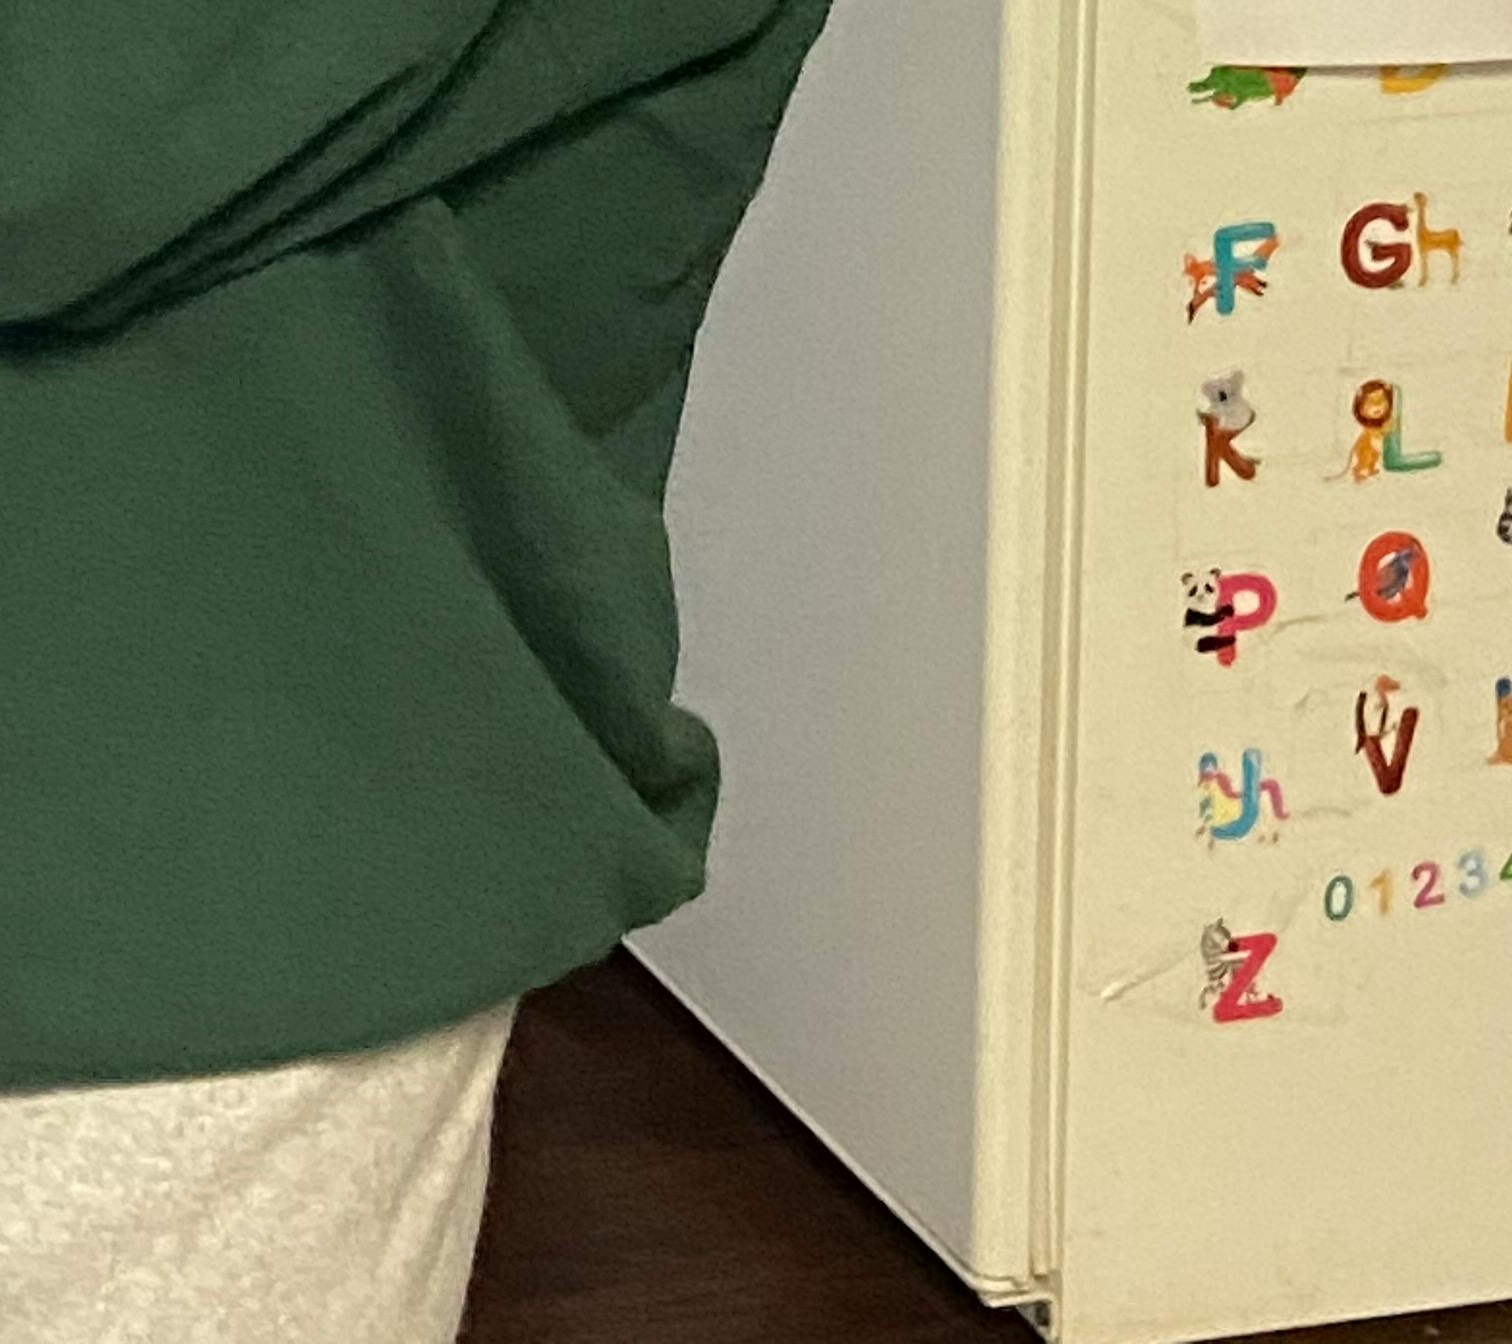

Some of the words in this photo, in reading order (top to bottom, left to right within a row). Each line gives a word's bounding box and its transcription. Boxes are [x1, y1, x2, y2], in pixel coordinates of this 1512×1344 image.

[1214, 221, 1275, 316] F
[1203, 409, 1257, 488] K
[1383, 384, 1443, 472] L
[1216, 573, 1278, 667] P
[1359, 531, 1430, 623] Q
[1213, 932, 1284, 1024] Z
